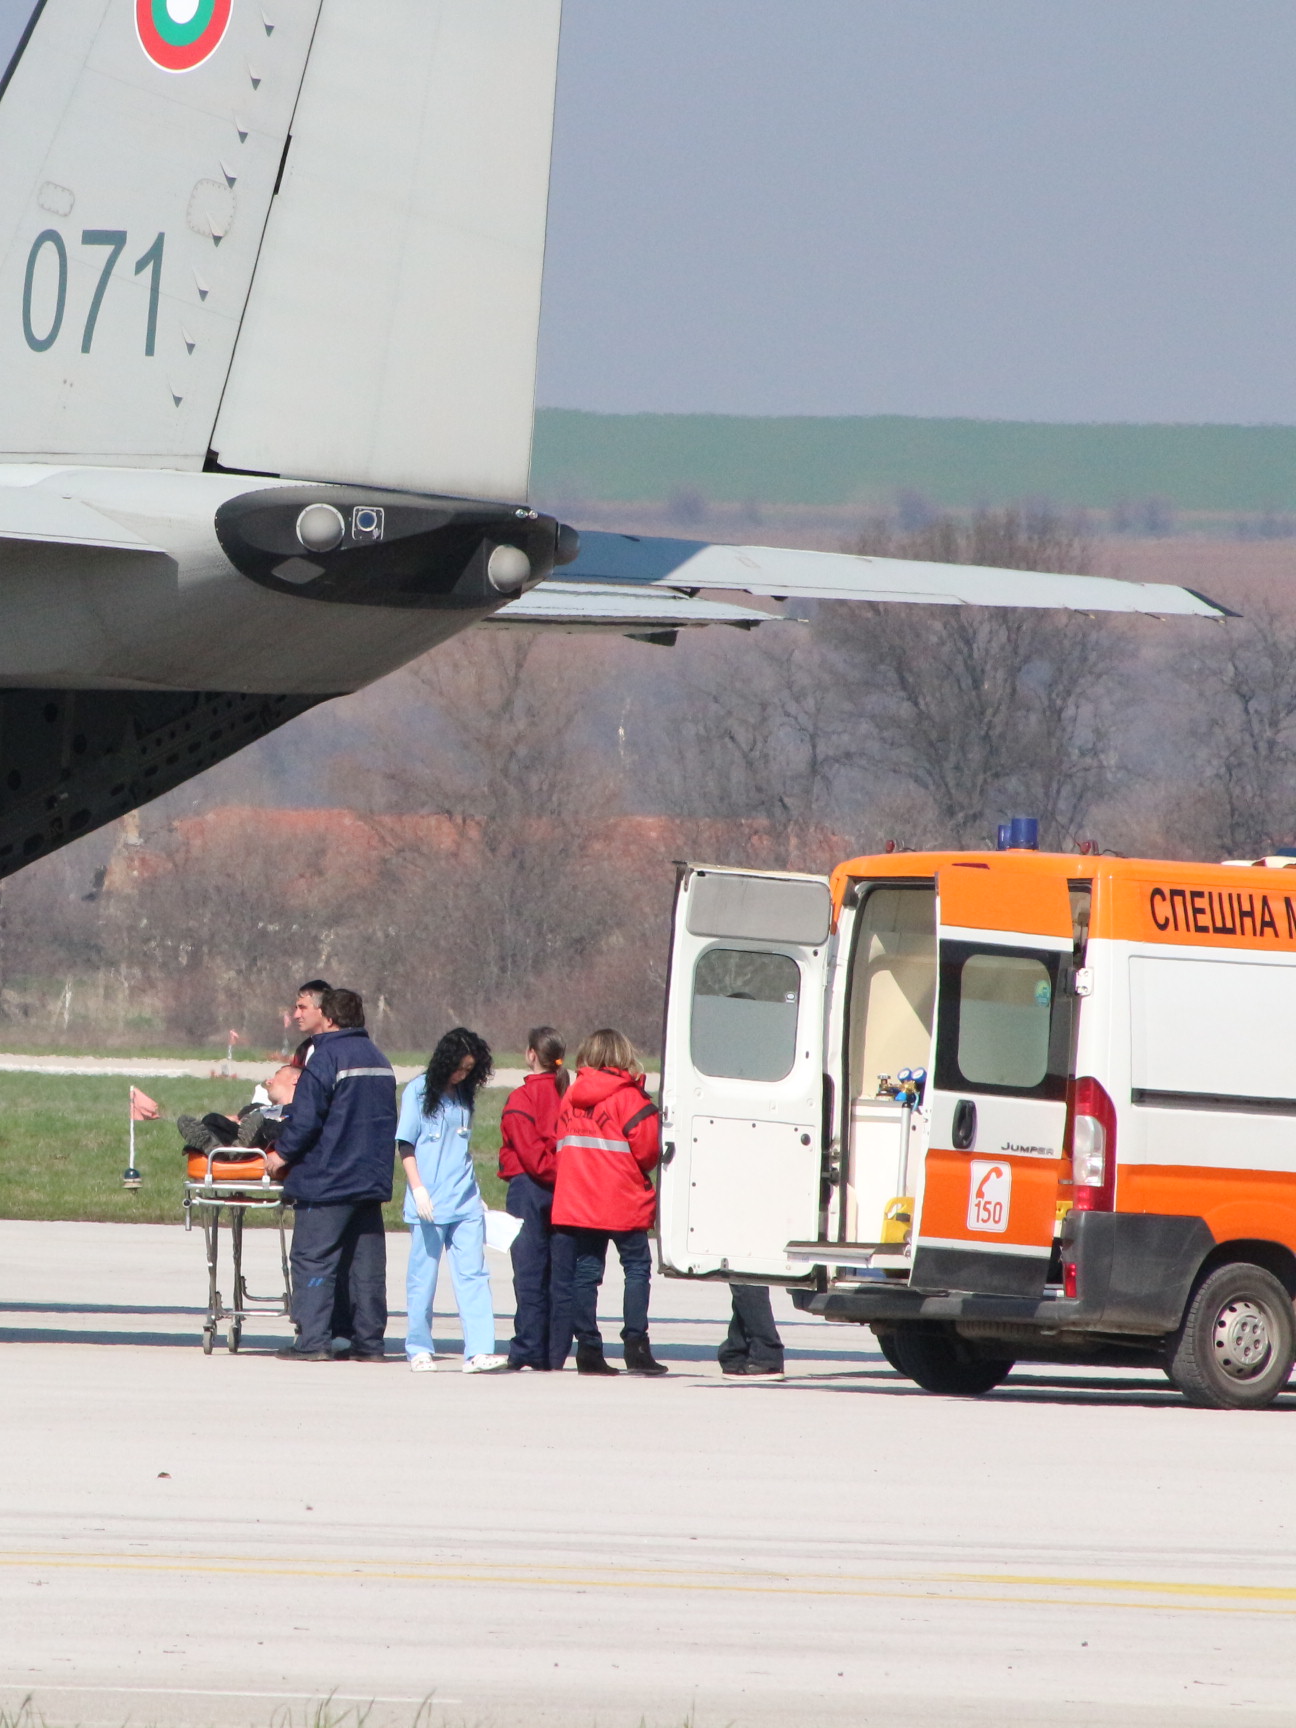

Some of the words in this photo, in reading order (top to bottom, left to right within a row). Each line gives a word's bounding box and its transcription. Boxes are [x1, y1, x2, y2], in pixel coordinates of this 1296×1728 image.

[23, 229, 166, 357] 071
[1150, 887, 1279, 938] СПЕШНА
[974, 1200, 1002, 1224] 150
